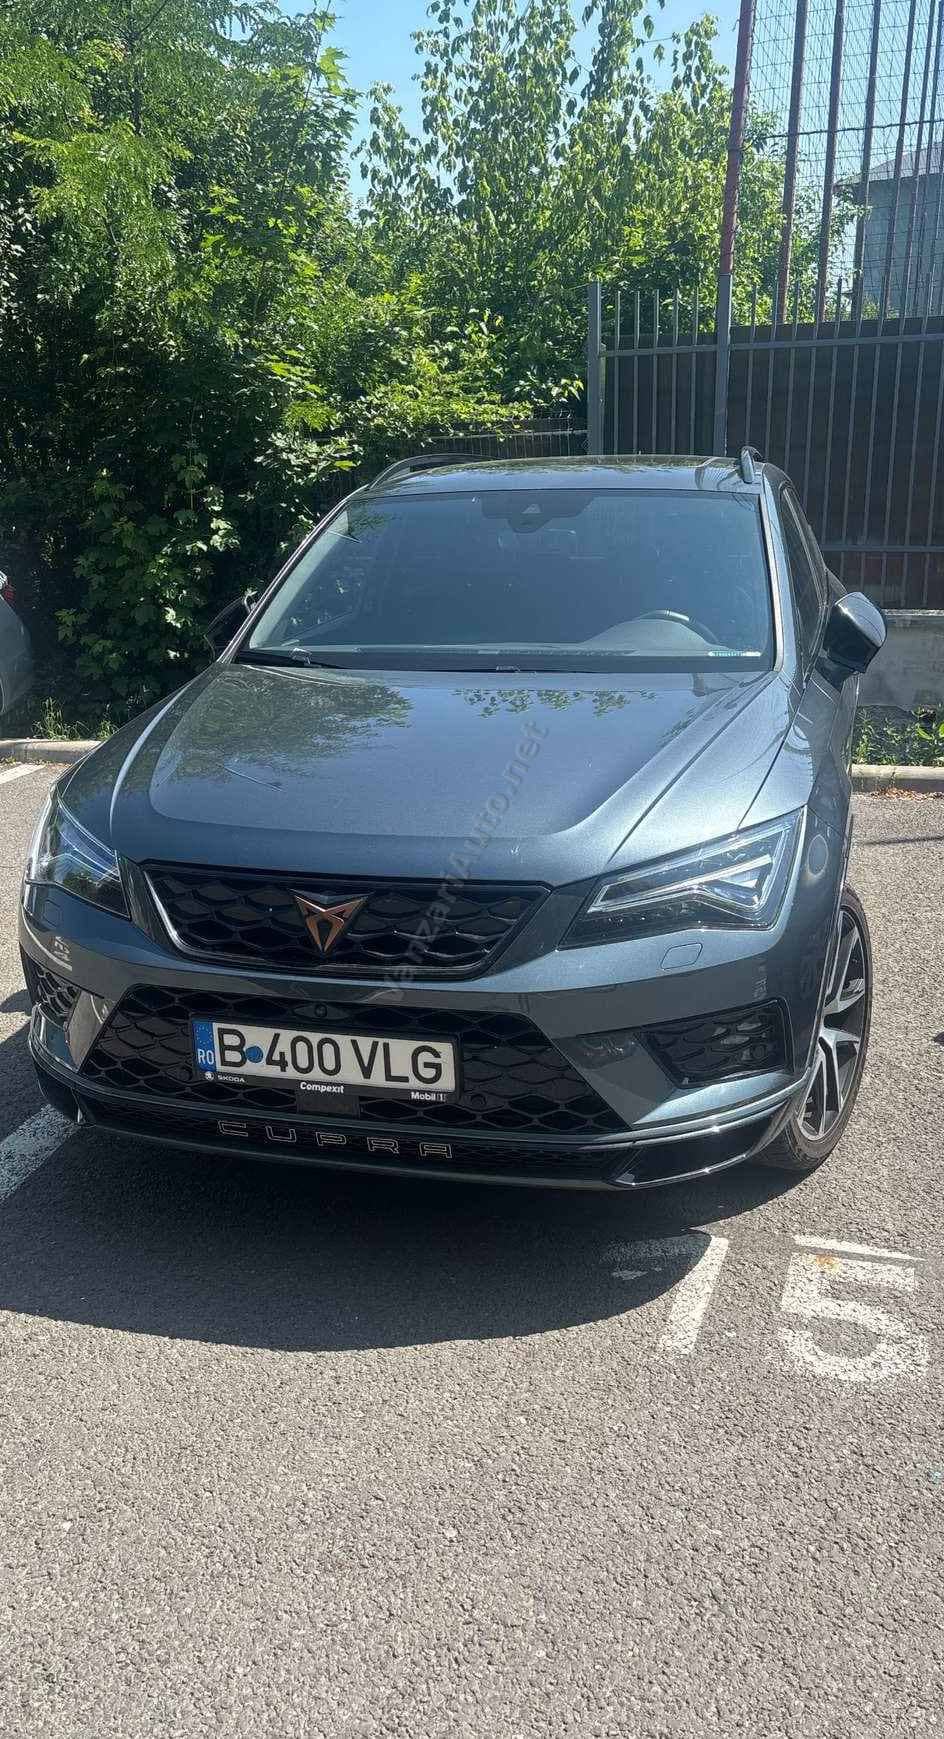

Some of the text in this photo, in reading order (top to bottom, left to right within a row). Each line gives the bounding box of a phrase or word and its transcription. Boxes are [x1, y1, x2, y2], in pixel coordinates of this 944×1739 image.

[197, 1049, 215, 1065] RO
[217, 1027, 442, 1084] B 400 VLG
[300, 1081, 344, 1094] Compexit
[218, 1120, 452, 1159] CUPRA
